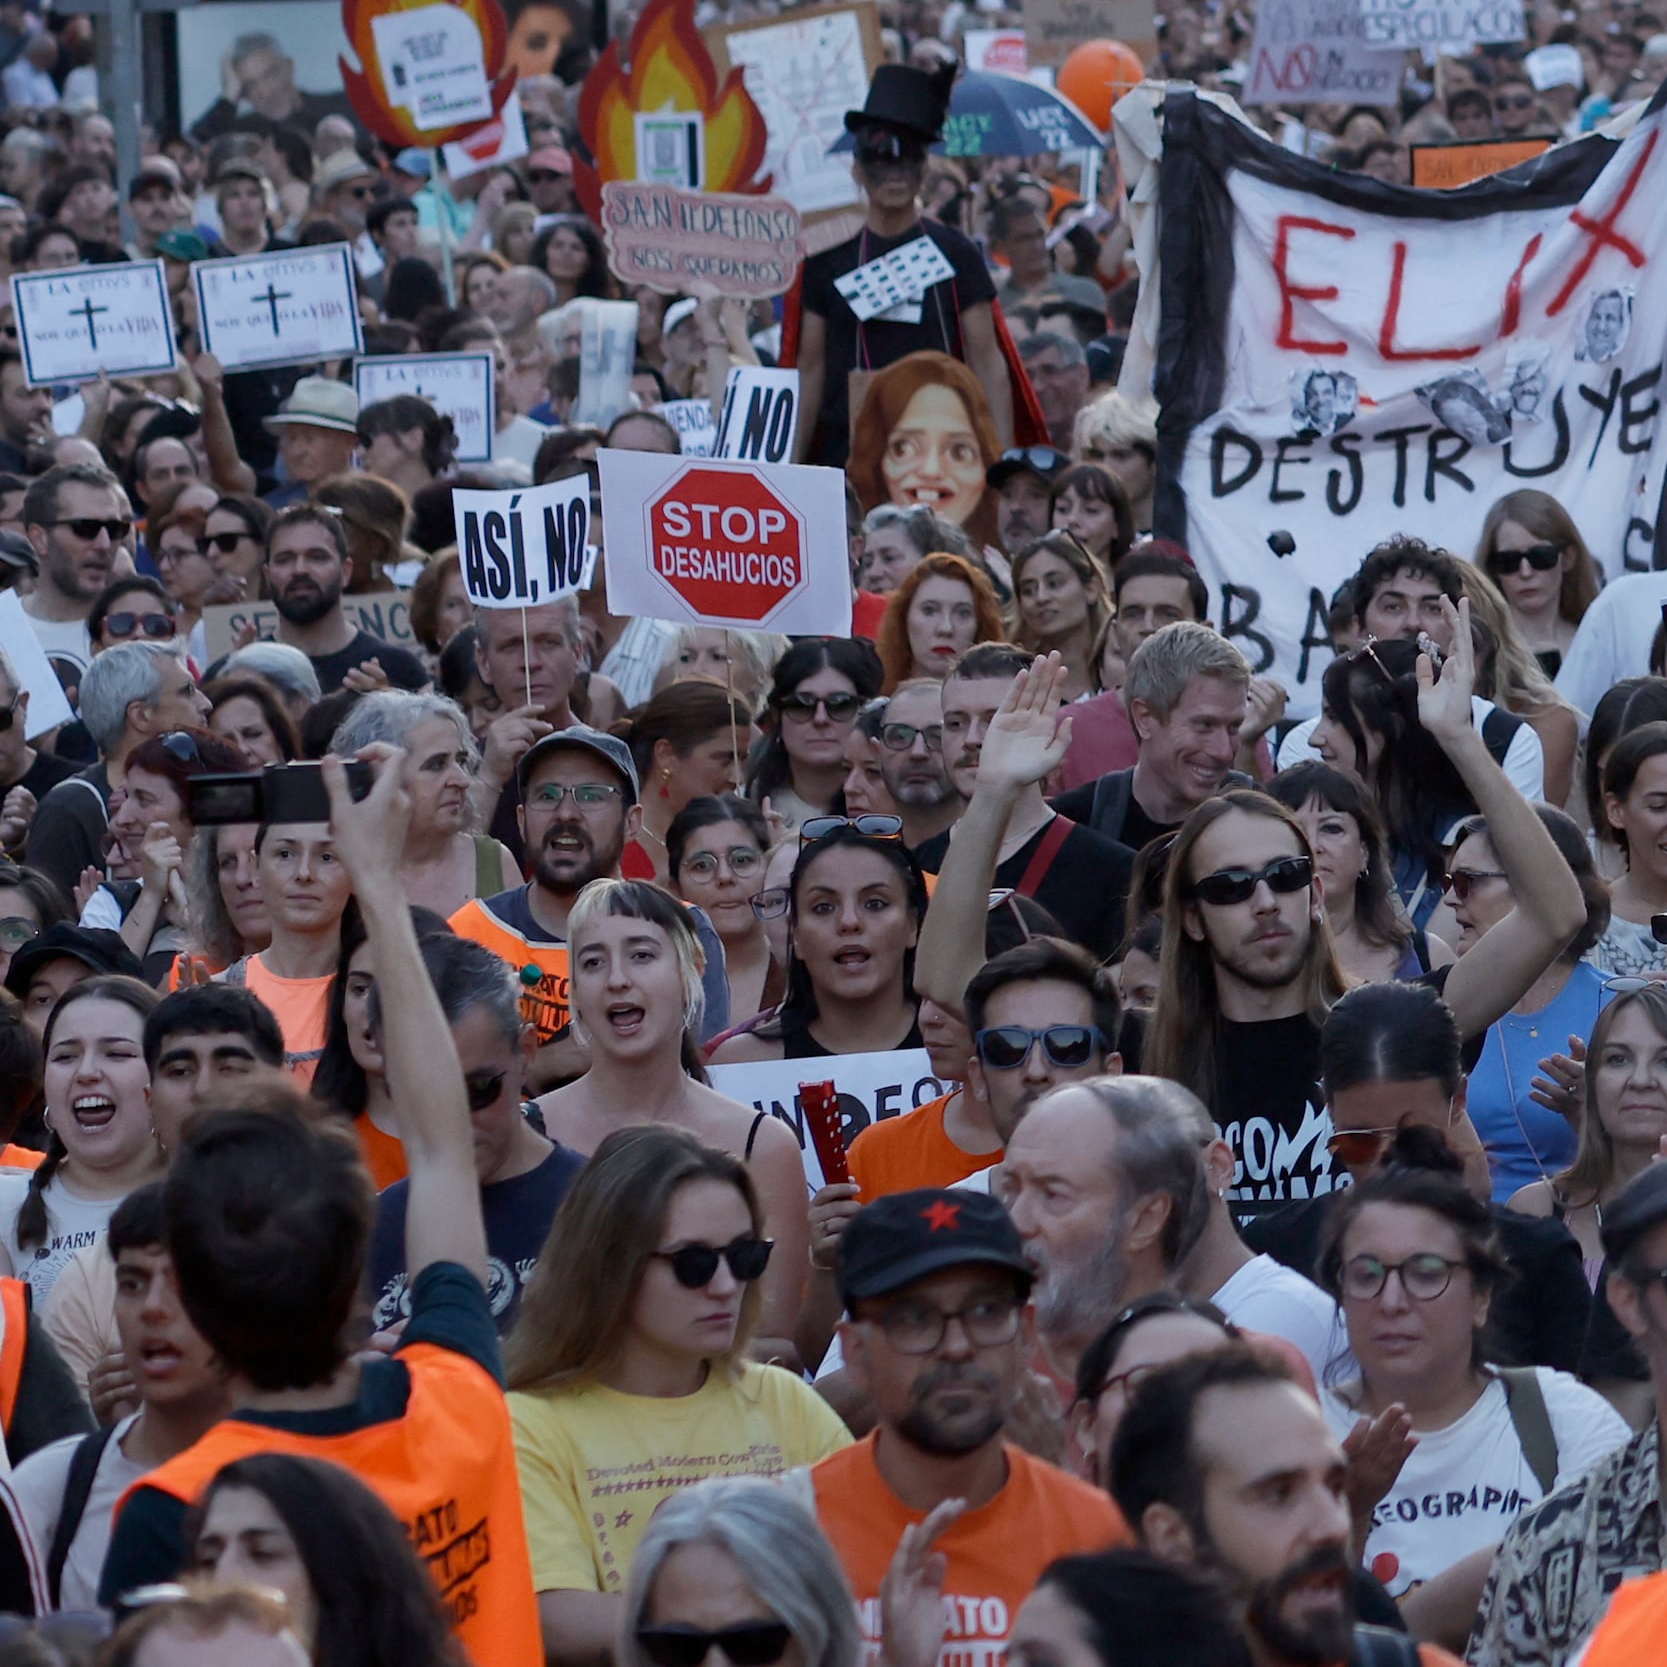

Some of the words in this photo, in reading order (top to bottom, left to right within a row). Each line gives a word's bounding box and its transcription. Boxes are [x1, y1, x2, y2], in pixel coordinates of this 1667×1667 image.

[612, 193, 672, 230] SAN
[631, 248, 674, 271] NOS
[683, 255, 784, 283] QUEDAMOS
[1271, 128, 1661, 362] ELIX
[737, 386, 794, 464] NO
[1208, 364, 1664, 517] DESTRUYE
[662, 500, 786, 545] STOP
[463, 494, 539, 602] ASÍ,
[542, 496, 589, 594] NO
[660, 544, 797, 588] DESAHUCIOS
[51, 1231, 97, 1251] WARM
